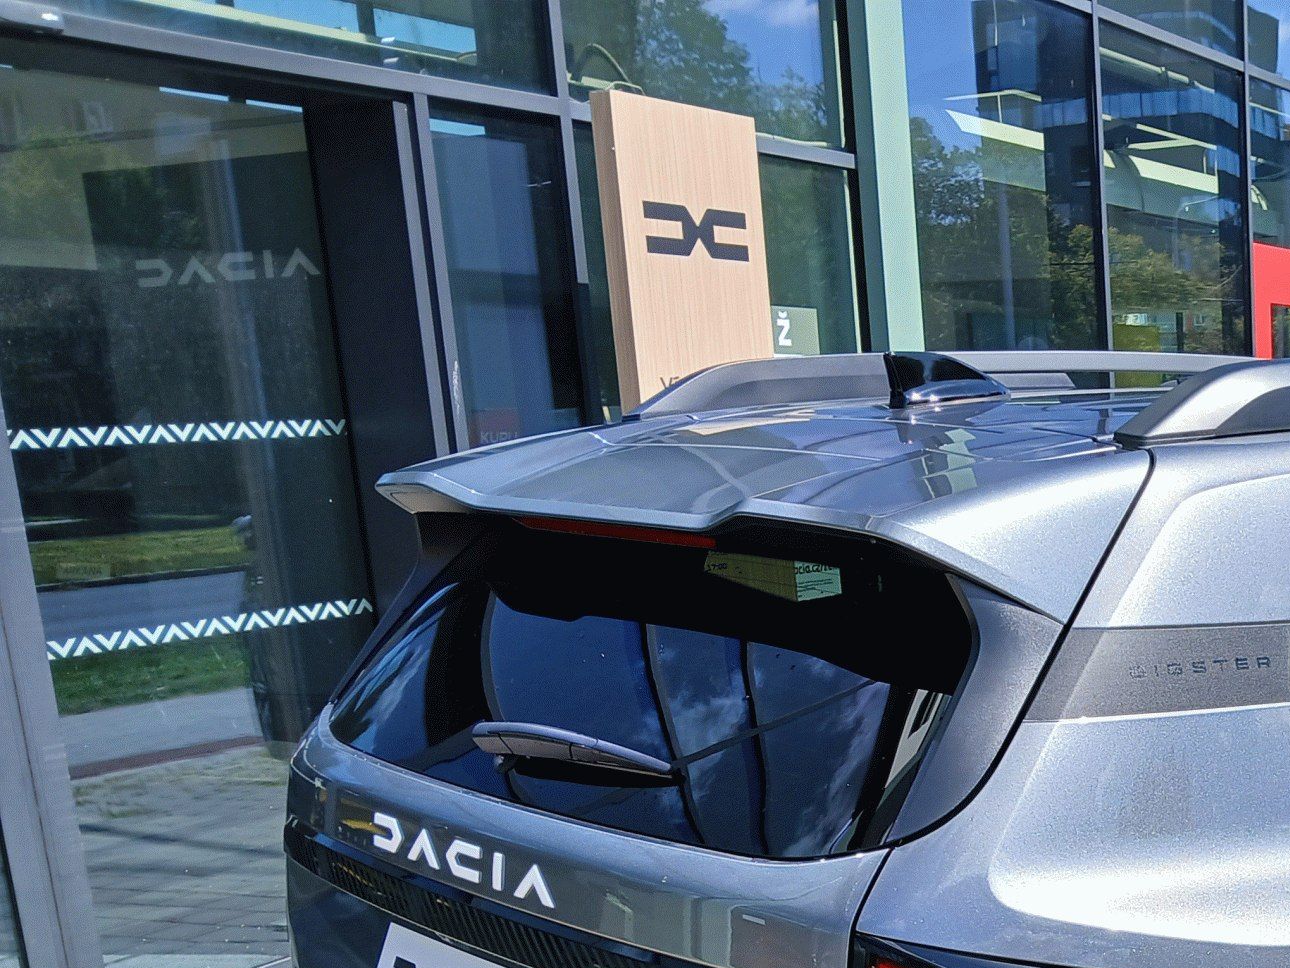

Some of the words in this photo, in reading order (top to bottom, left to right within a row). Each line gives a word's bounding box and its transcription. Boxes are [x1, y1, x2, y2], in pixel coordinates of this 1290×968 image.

[135, 248, 321, 288] DACIA
[1129, 656, 1271, 679] BIGSTER
[373, 812, 555, 908] DACIA
